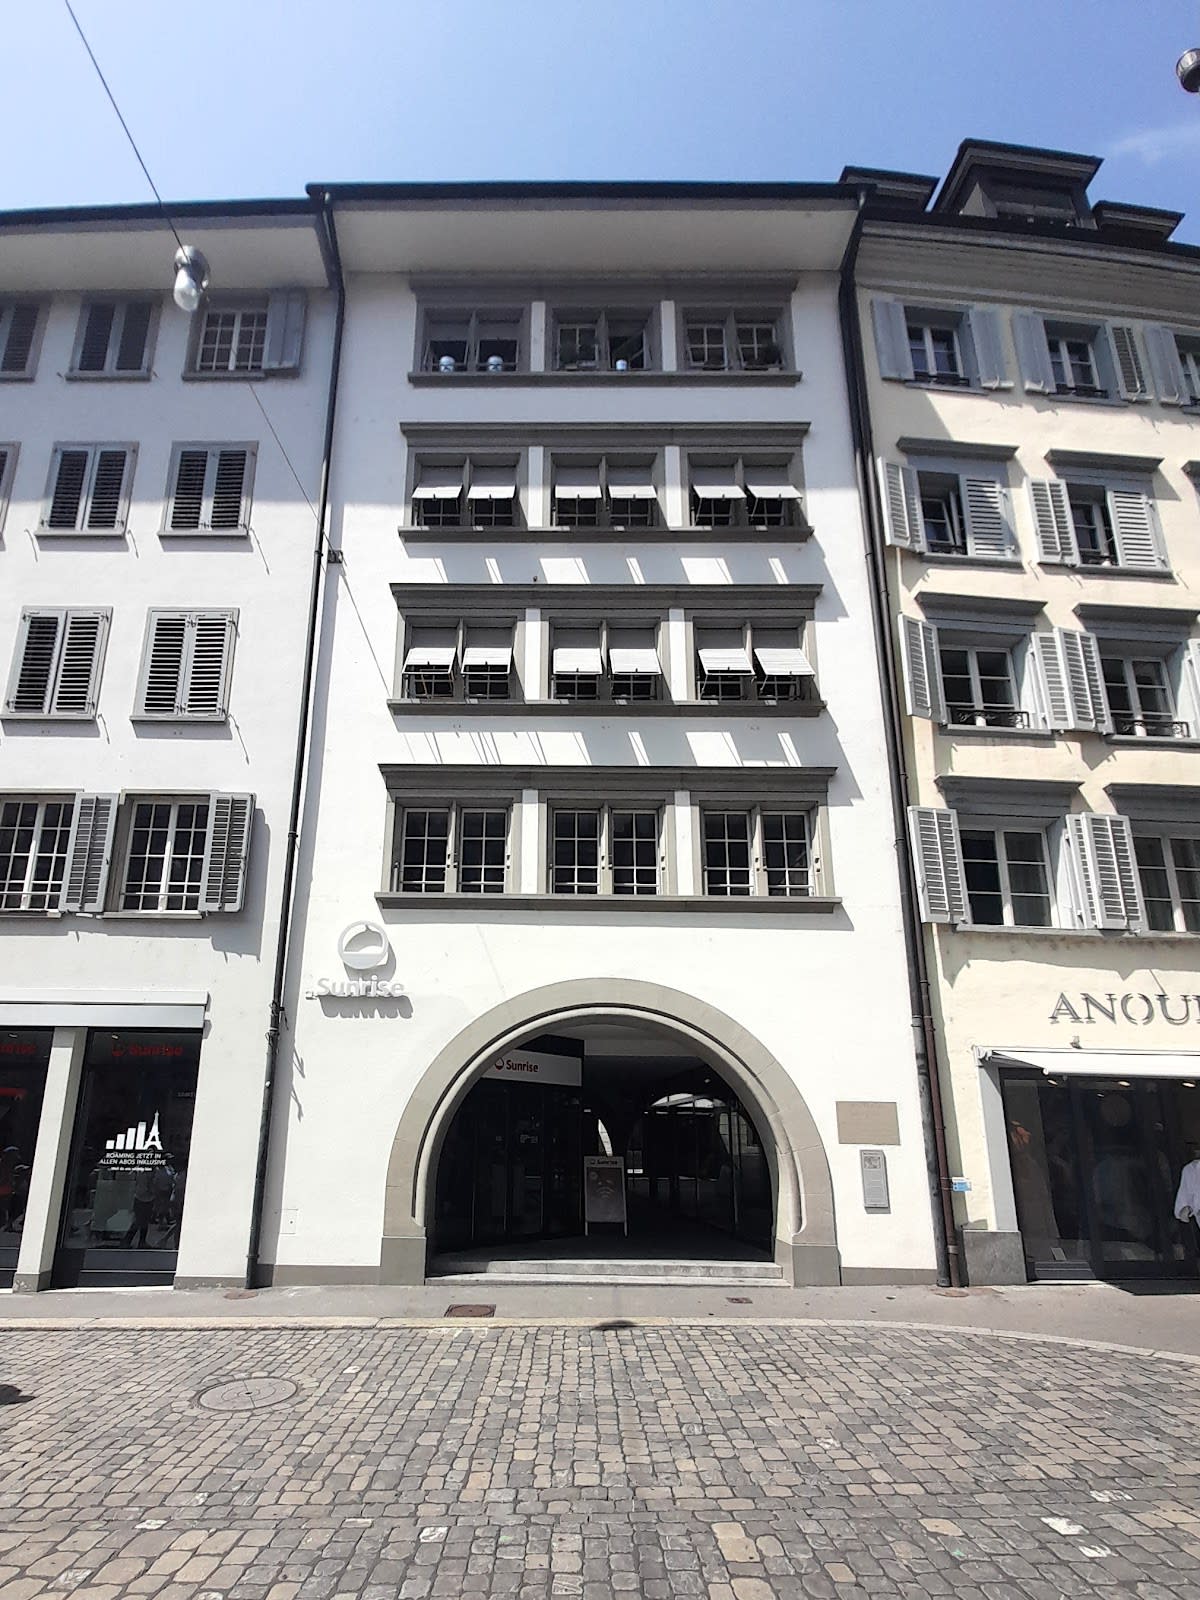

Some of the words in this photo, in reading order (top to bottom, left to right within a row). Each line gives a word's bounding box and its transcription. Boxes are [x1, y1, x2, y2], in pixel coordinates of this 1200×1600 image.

[317, 975, 405, 997] Sunrise
[1048, 992, 1200, 1024] ANOU
[506, 1060, 539, 1073] Sunrise
